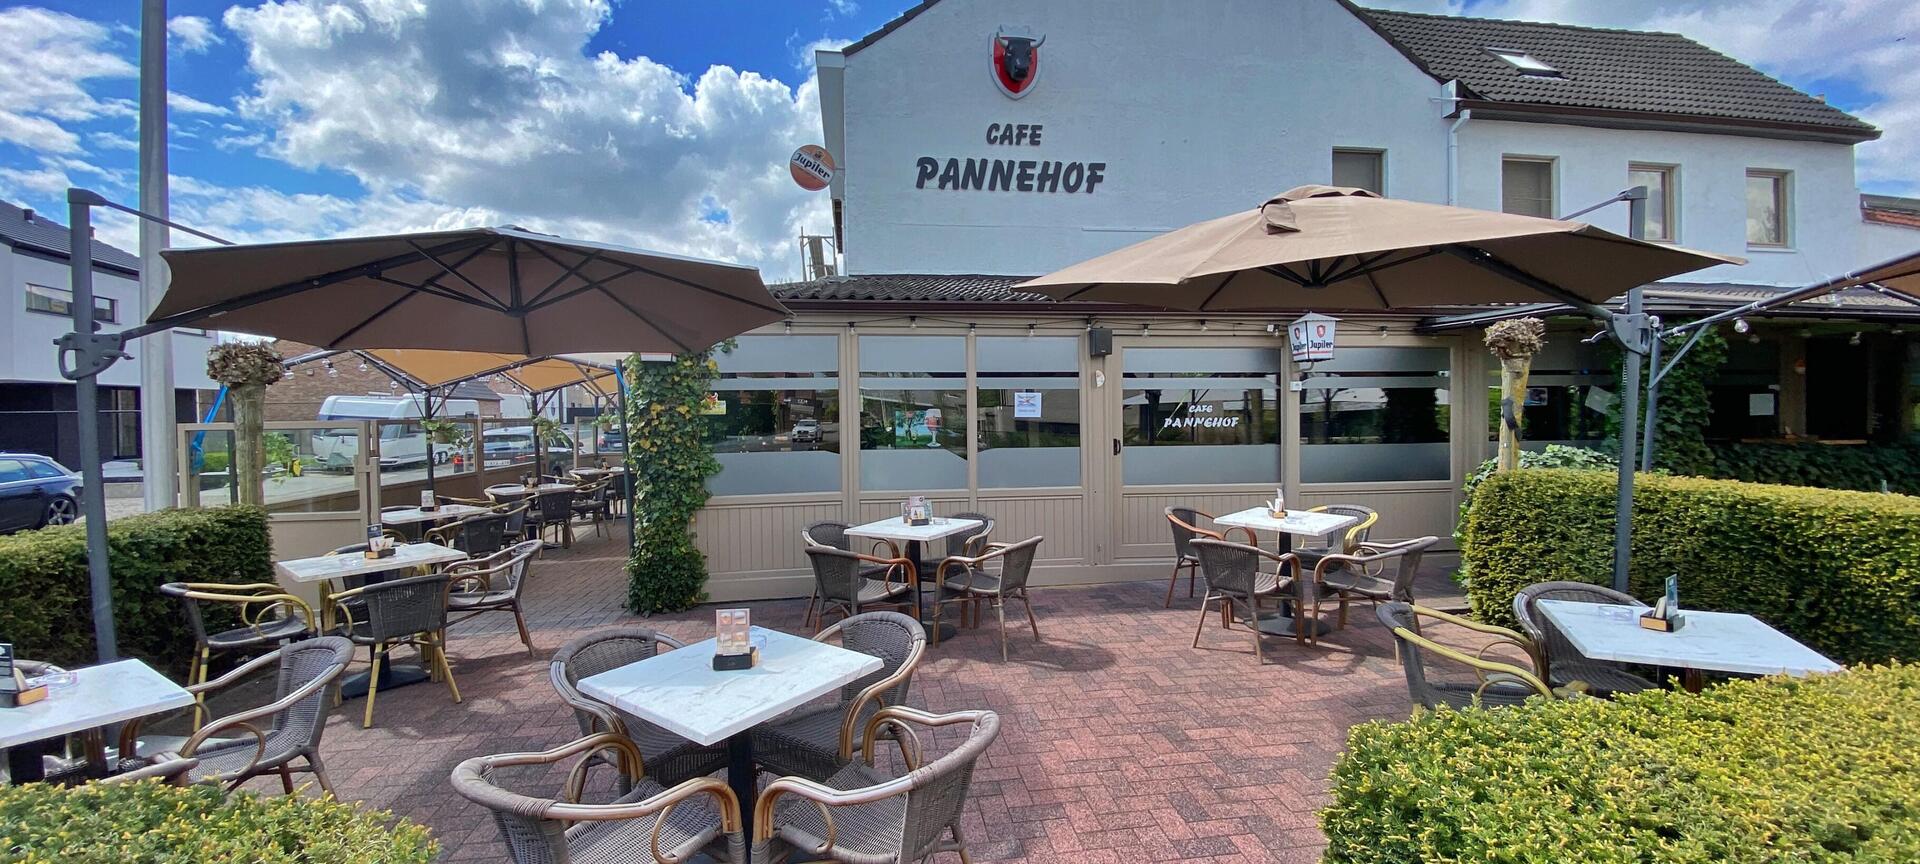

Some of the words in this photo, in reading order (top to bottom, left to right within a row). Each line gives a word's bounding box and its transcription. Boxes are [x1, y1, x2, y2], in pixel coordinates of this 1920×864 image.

[986, 123, 1043, 146] CAFE
[793, 152, 830, 179] Jupiler
[916, 156, 1106, 194] PANNEHOF
[1310, 340, 1333, 351] Jupiler
[1189, 405, 1213, 413] CAFE
[1164, 417, 1239, 428] PANNEHOF
